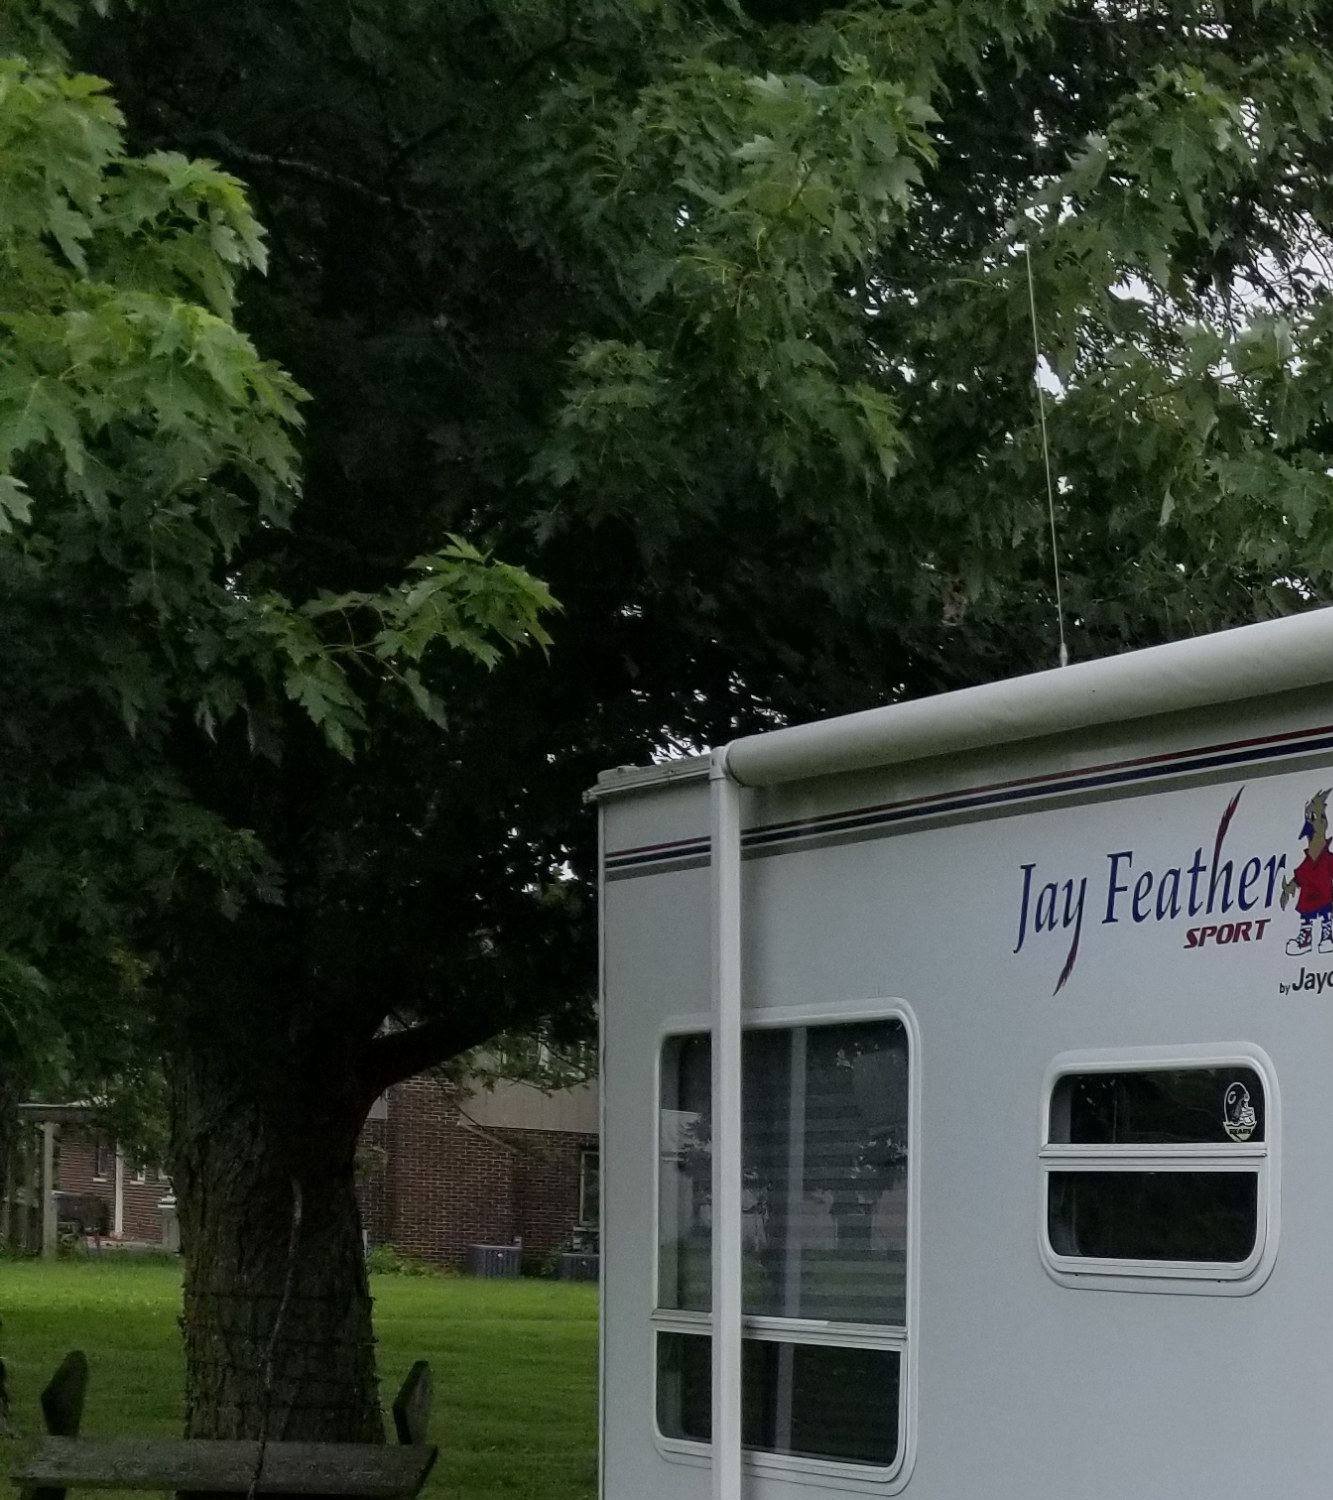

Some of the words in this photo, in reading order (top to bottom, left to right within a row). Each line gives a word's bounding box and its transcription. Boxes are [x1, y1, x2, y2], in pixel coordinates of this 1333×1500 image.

[1013, 863, 1088, 996] Jay
[1101, 785, 1288, 925] Feather
[1183, 918, 1271, 949] SPORT
[1279, 983, 1291, 995] by
